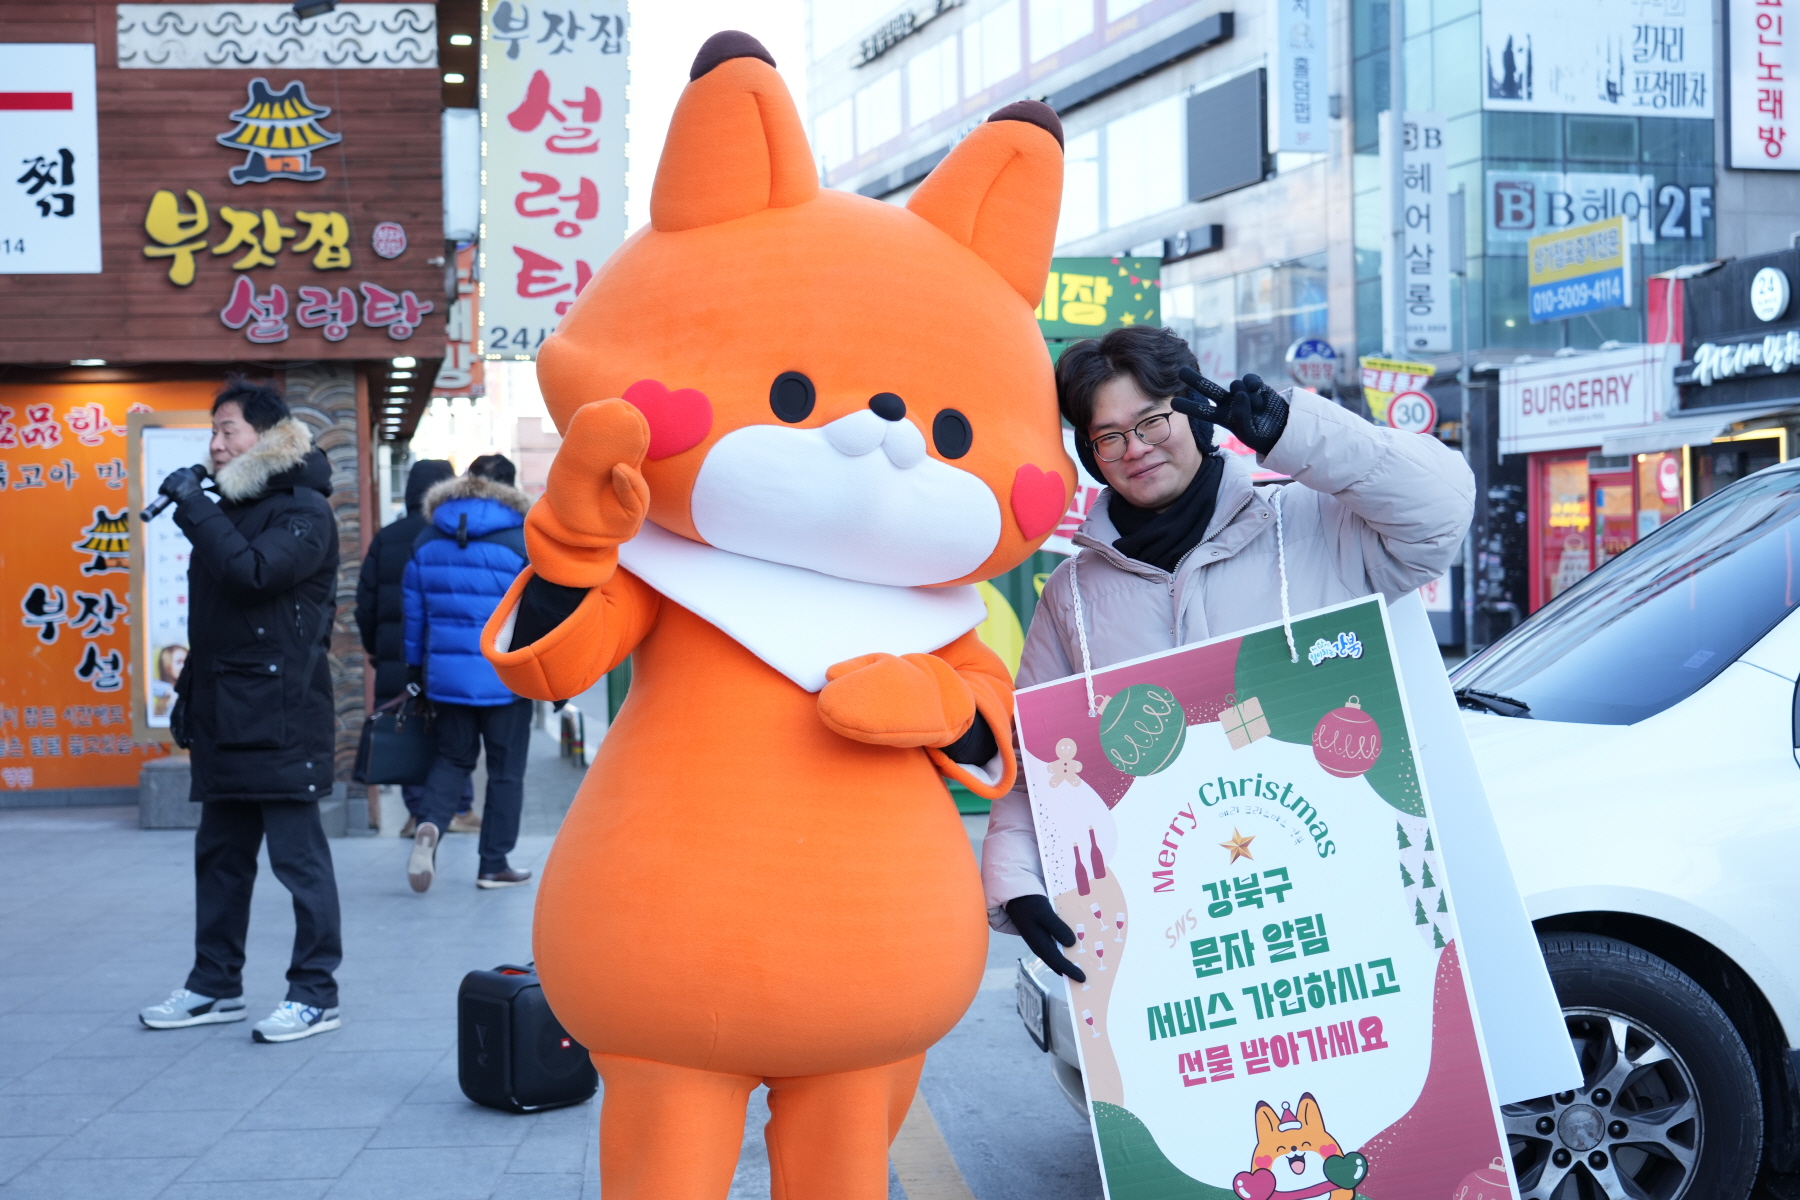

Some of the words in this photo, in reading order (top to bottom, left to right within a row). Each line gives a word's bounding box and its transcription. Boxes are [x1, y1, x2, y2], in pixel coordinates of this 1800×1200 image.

[492, 1, 625, 60] 부잣집
[1631, 23, 1684, 63] 길거리
[1632, 69, 1708, 110] 포장마차
[1755, 0, 1786, 159] 인노래방
[143, 188, 353, 288] 부잣집
[1402, 162, 1435, 317] 헤어살롱
[1659, 185, 1713, 239] 2F
[220, 274, 434, 344] 설렁탕
[1533, 276, 1622, 316] 010-5009-4114
[1396, 402, 1426, 426] 30
[1521, 374, 1634, 417] BURGERRY
[21, 584, 131, 645] 부잣
[1332, 632, 1361, 657] 강북
[1152, 802, 1197, 893] Merry
[1198, 772, 1337, 859] Christmas
[1202, 866, 1293, 919] 강북구
[1164, 908, 1198, 949] SNS
[1190, 929, 1256, 979] 문자
[1262, 913, 1330, 964] 알림
[1147, 991, 1238, 1041] 서비스
[1241, 957, 1401, 1020] 가입하시고
[1178, 1044, 1236, 1088] 선물
[1240, 1015, 1389, 1076] 받아가세요
